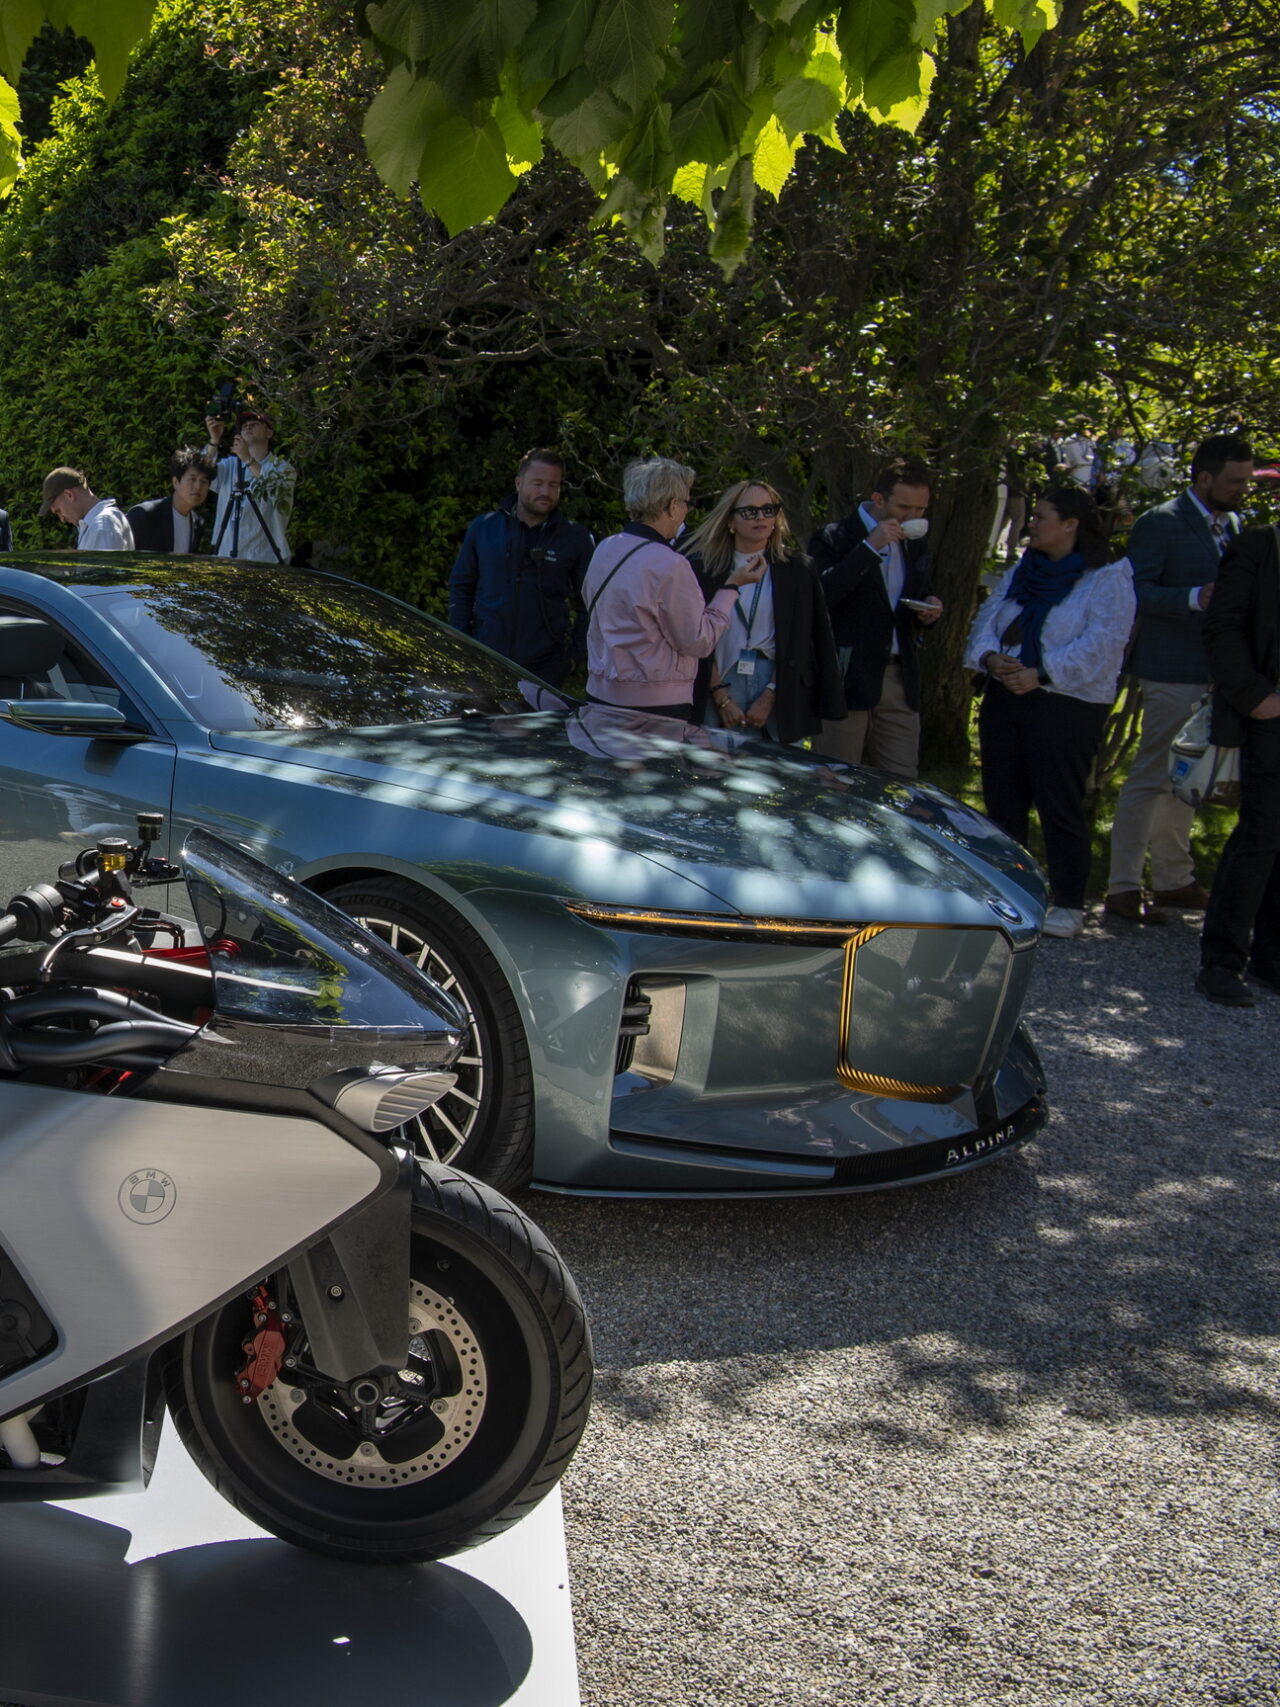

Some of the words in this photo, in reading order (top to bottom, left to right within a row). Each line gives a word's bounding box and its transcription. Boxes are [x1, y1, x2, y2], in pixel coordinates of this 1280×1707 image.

[340, 895, 403, 910] MICHELIN
[946, 1124, 1016, 1162] ALPINA
[128, 1171, 172, 1188] BMW
